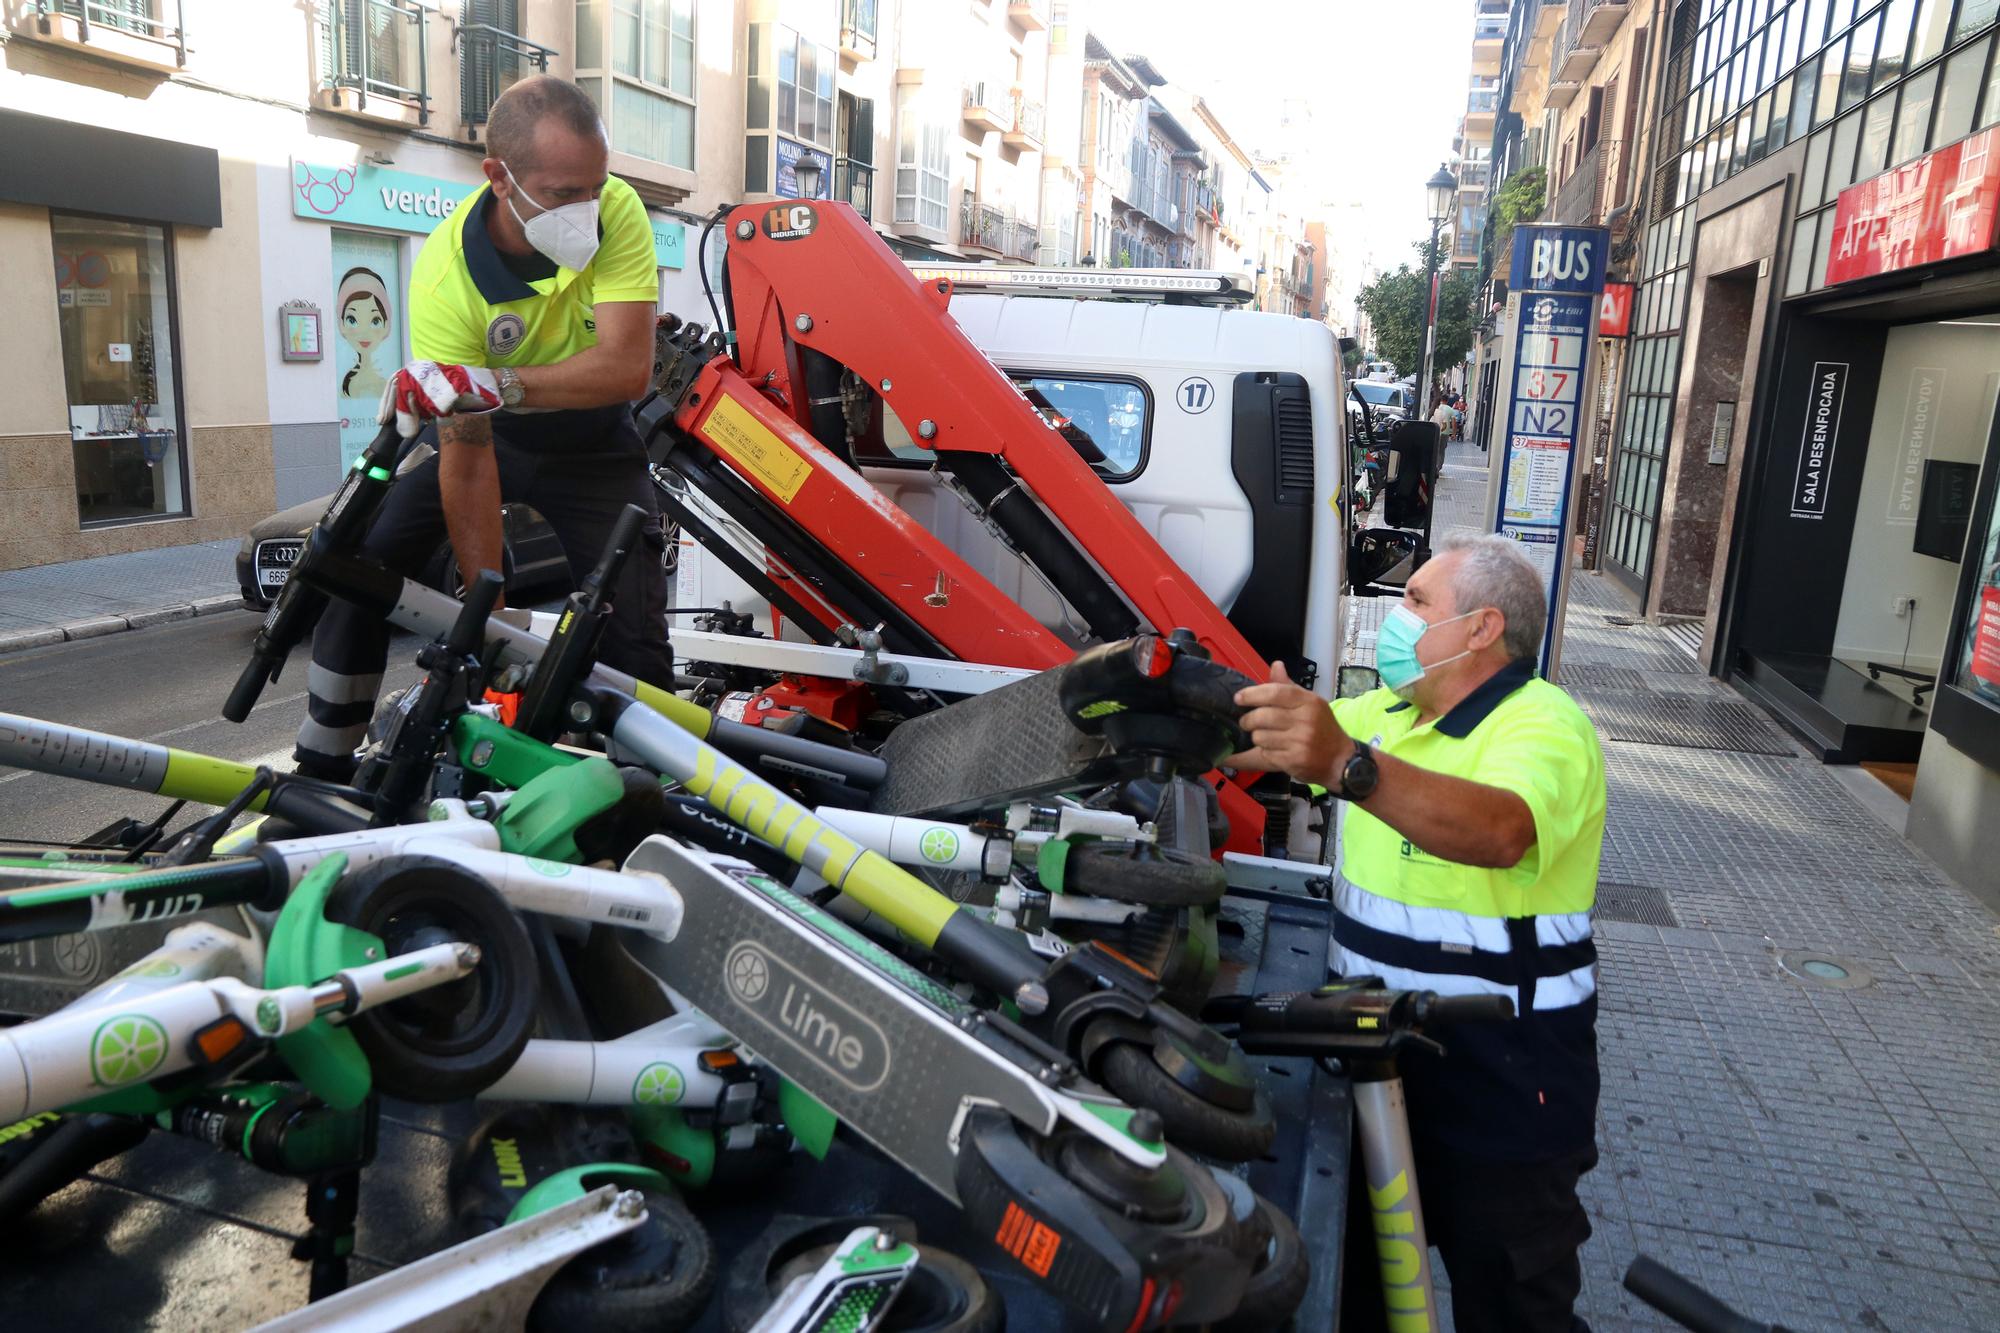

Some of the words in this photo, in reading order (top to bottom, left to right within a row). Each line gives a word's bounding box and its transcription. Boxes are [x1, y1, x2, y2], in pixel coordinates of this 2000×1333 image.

[779, 141, 801, 160] MOLINO
[381, 184, 460, 218] verde
[770, 206, 811, 232] HC
[771, 229, 811, 238] INDUSTRIE
[654, 230, 677, 247] ÉTICA
[1530, 239, 1592, 281] BUS
[1550, 337, 1559, 364] 1
[1185, 384, 1207, 407] 17
[1528, 371, 1568, 400] 37
[1523, 406, 1567, 435] N2
[1809, 372, 1837, 467] DESENFOCADA
[1803, 470, 1820, 504] SALA
[269, 571, 290, 583] 666
[680, 803, 748, 845] Lime
[780, 983, 863, 1070] Lime
[1357, 1017, 1378, 1028] LINK
[491, 1136, 527, 1187] LINK
